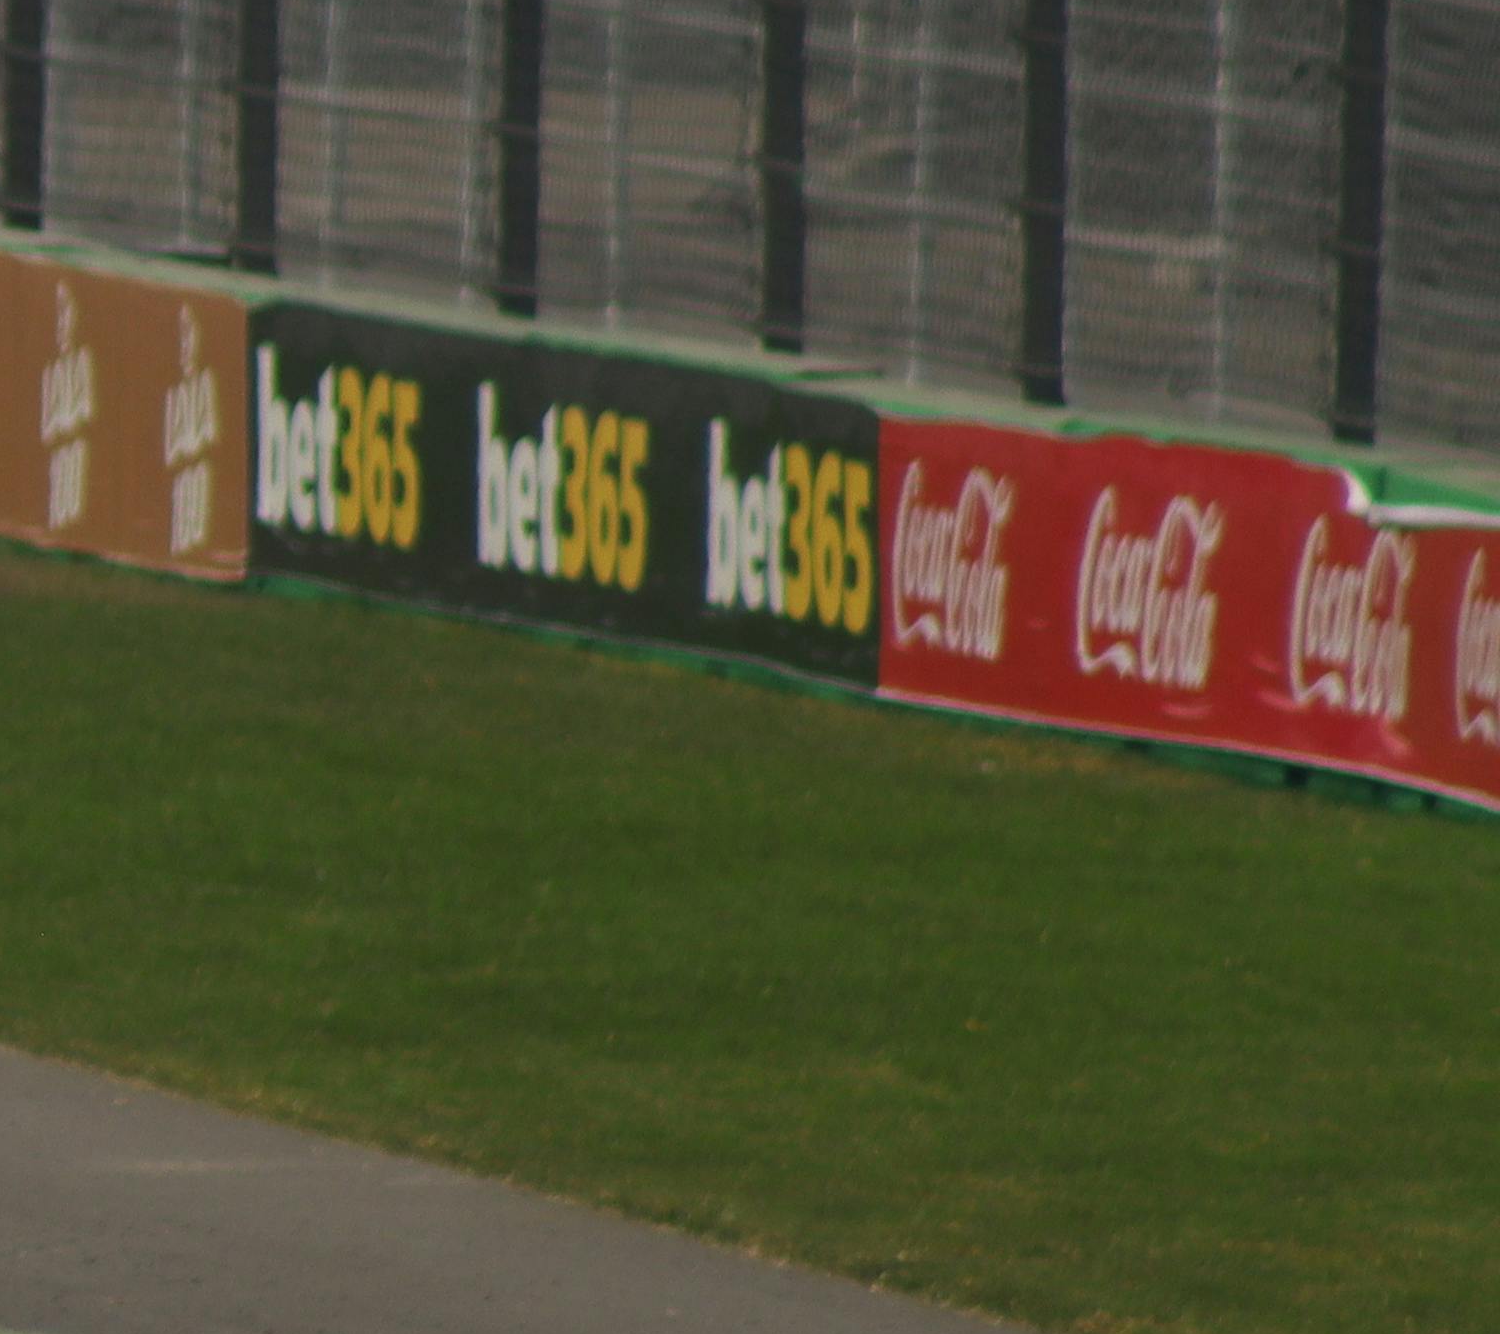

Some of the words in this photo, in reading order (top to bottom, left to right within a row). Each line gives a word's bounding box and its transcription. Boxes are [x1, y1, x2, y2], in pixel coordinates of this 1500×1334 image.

[256, 342, 422, 551] bet365
[476, 380, 649, 593] bet365
[706, 417, 873, 636] bet365
